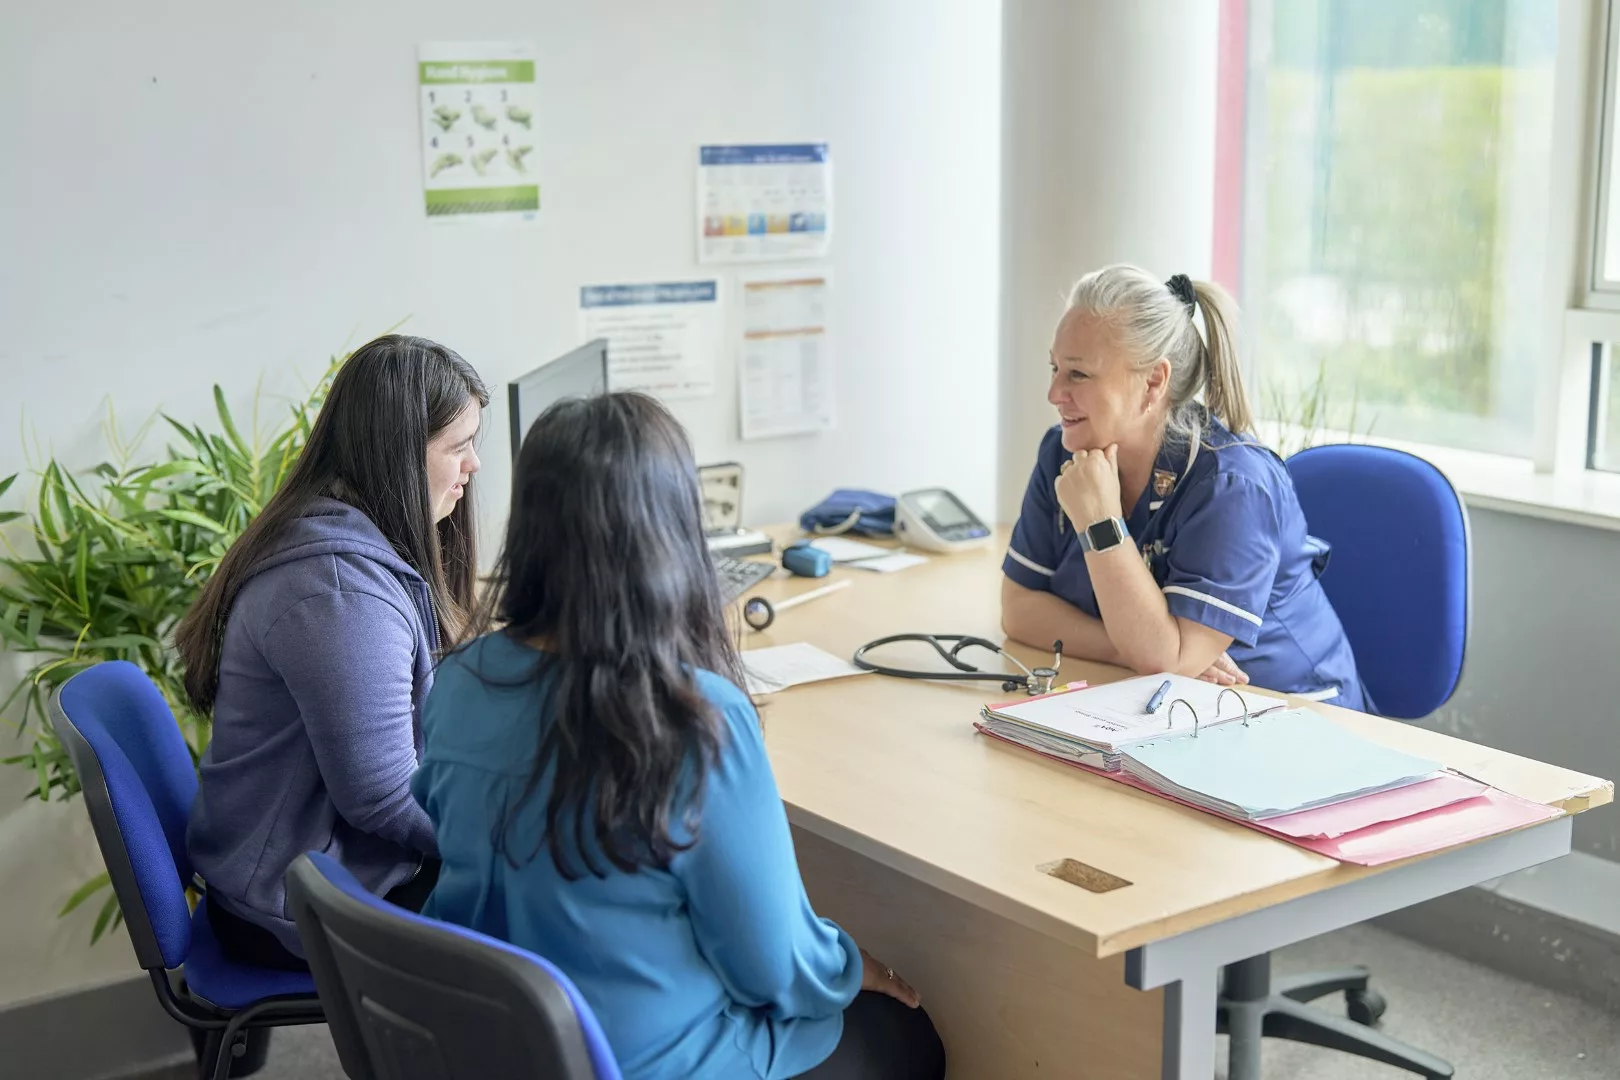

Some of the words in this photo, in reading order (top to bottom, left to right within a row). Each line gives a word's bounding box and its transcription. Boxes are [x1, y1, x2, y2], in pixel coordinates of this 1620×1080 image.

[429, 91, 435, 104] 1
[465, 90, 472, 103] 2
[500, 89, 508, 103] 3
